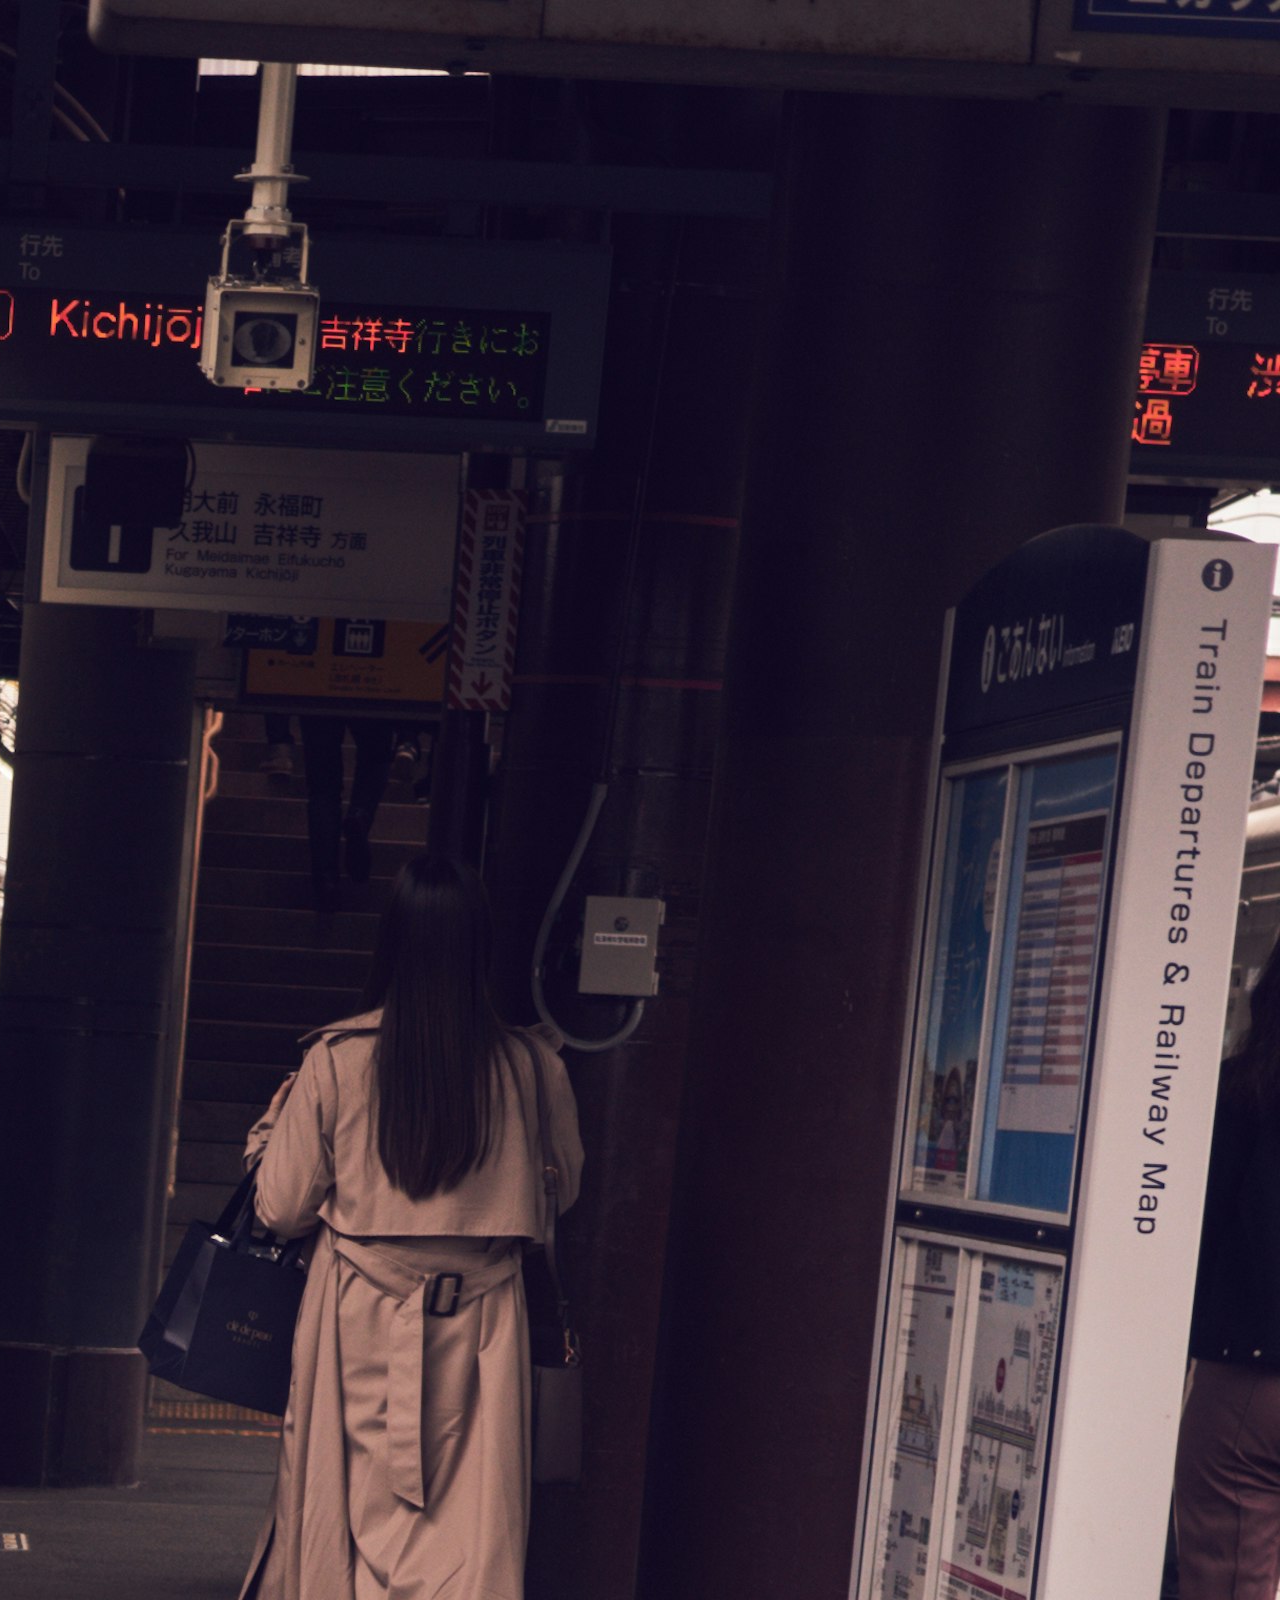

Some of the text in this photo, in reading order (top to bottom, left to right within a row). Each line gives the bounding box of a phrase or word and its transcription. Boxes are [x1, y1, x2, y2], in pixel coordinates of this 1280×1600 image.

[20, 234, 64, 259] 行先
[19, 262, 41, 282] To
[1208, 289, 1253, 312] 行先
[49, 299, 203, 350] Kichijōj
[320, 312, 540, 357] 吉祥寺行きにお
[1205, 317, 1228, 335] To
[254, 493, 323, 519] 永福町
[168, 522, 368, 552] 久我山 吉祥寺 方面
[166, 549, 189, 562] For
[198, 550, 270, 565] Meidaimae
[165, 564, 237, 581] Kugayama
[1134, 617, 1228, 1237] Train Departures & Railway Map
